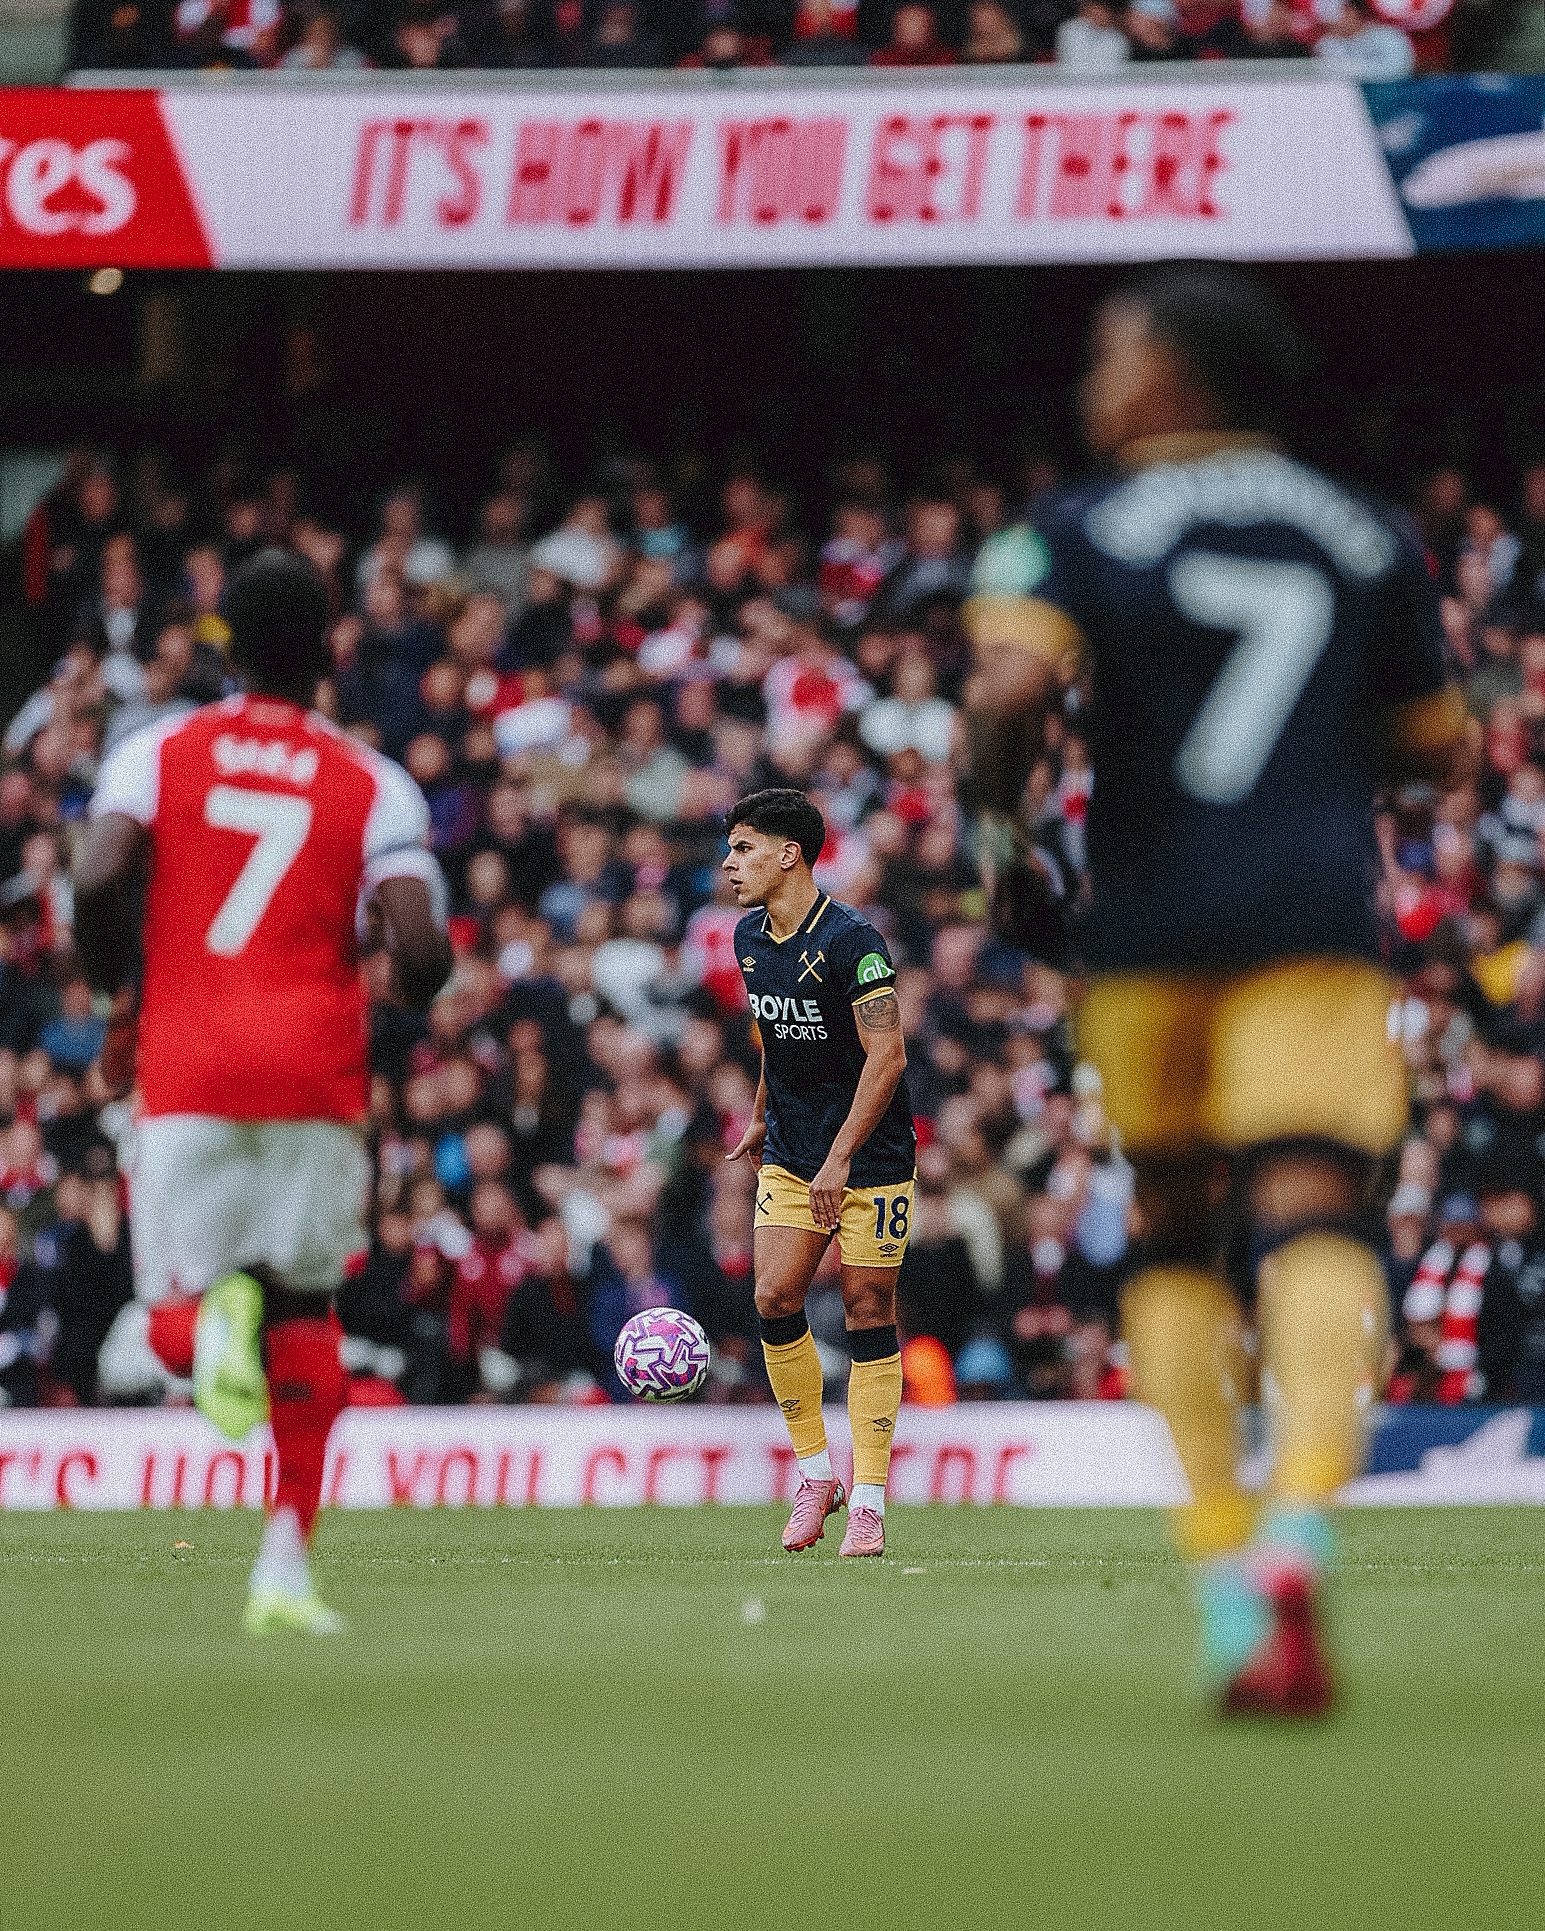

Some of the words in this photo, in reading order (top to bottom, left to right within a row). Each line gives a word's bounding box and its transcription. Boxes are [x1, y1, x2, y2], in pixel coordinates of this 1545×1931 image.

[0, 138, 137, 236] es
[349, 115, 492, 227] IT'S
[505, 115, 694, 226] HOW
[716, 115, 850, 225] YOU
[864, 113, 990, 225] GET
[1015, 111, 1236, 223] THERE
[1168, 550, 1334, 803] 7
[204, 785, 313, 957] 7
[747, 993, 823, 1023] BOYLE
[774, 1023, 828, 1041] SPORTS
[873, 1195, 910, 1240] 18
